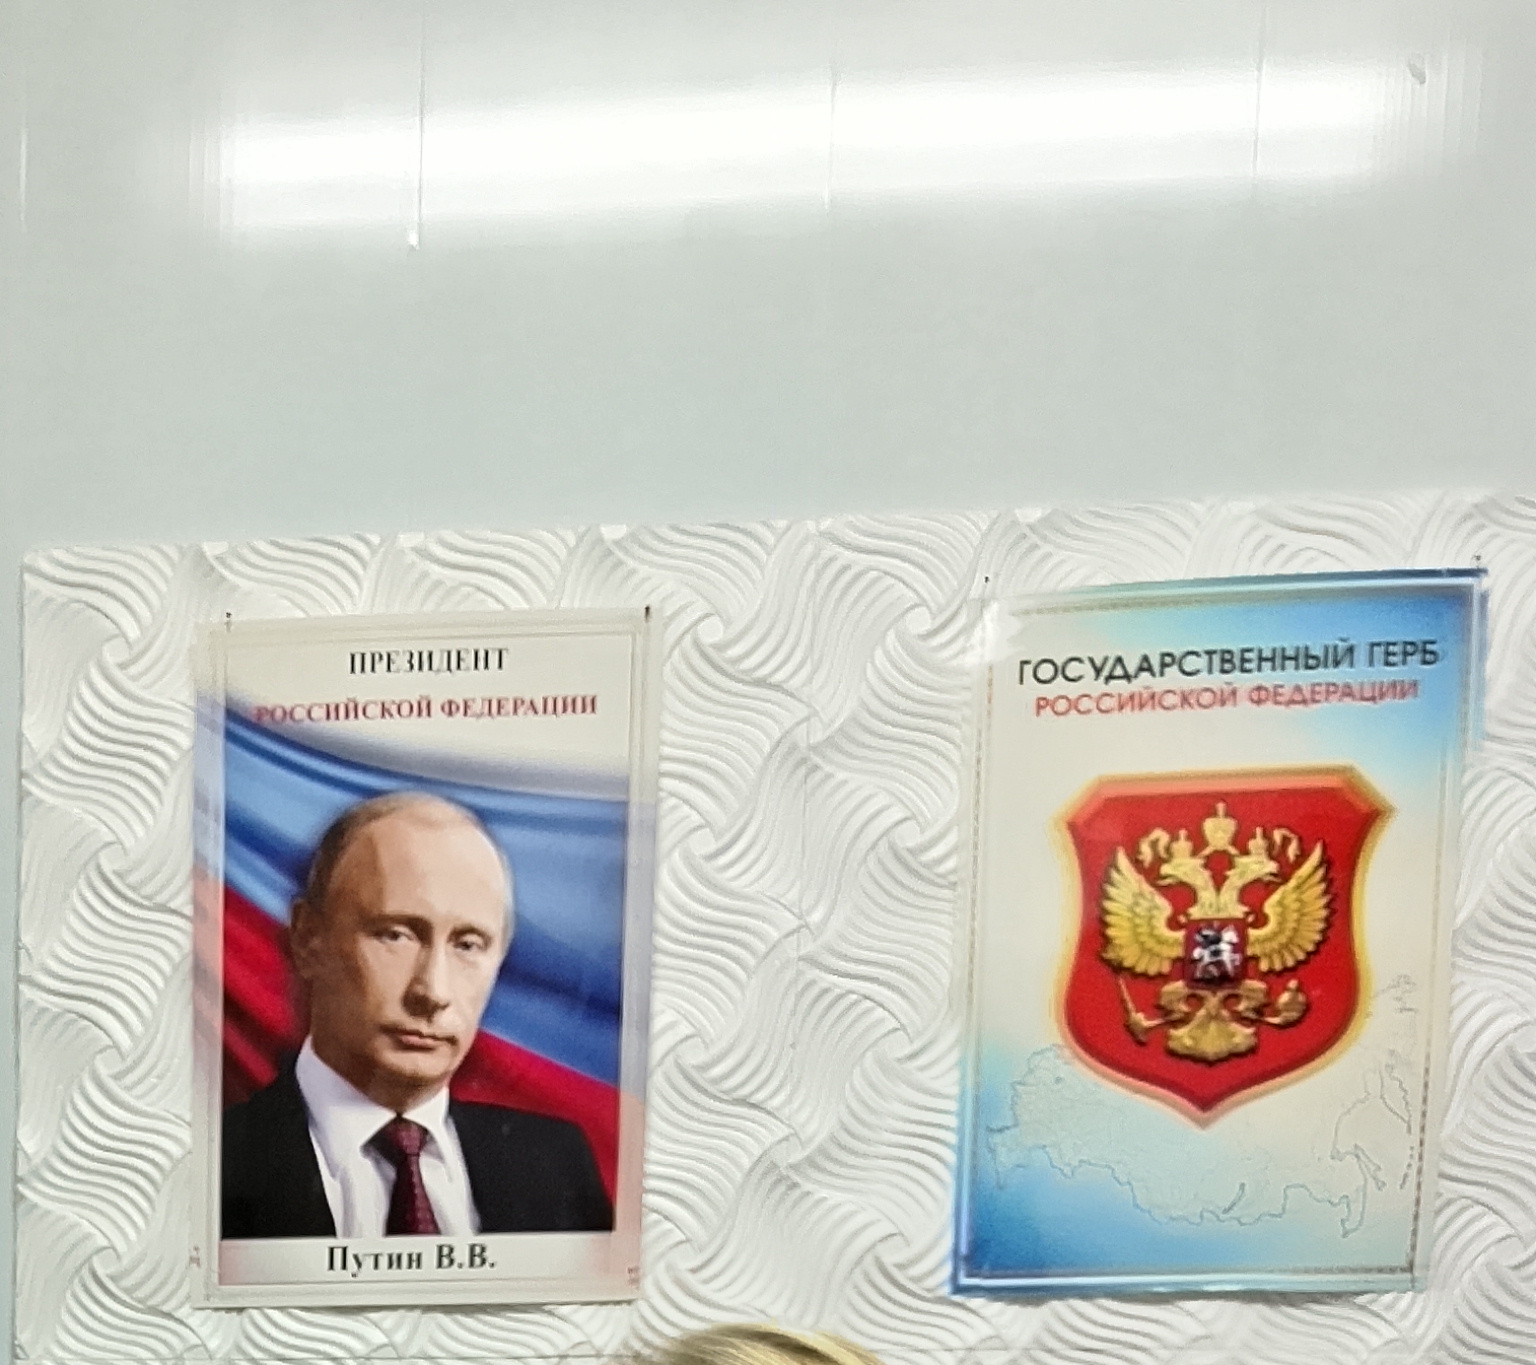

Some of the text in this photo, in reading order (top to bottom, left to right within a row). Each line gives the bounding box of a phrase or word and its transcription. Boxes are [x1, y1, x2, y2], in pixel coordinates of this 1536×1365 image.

[349, 648, 509, 674] ПРЕЗИДЕНТ
[1019, 636, 1440, 685] ГОСУДАРСТВЕННЫЙ ГЕРБ
[255, 694, 598, 723] РОССИЙСКОЙ ФЕДЕРАЦИИ
[1034, 679, 1419, 717] РОССИЙСКОЙ ФЕДЕРАЦИИ
[327, 1243, 496, 1277] Путин В.В.
